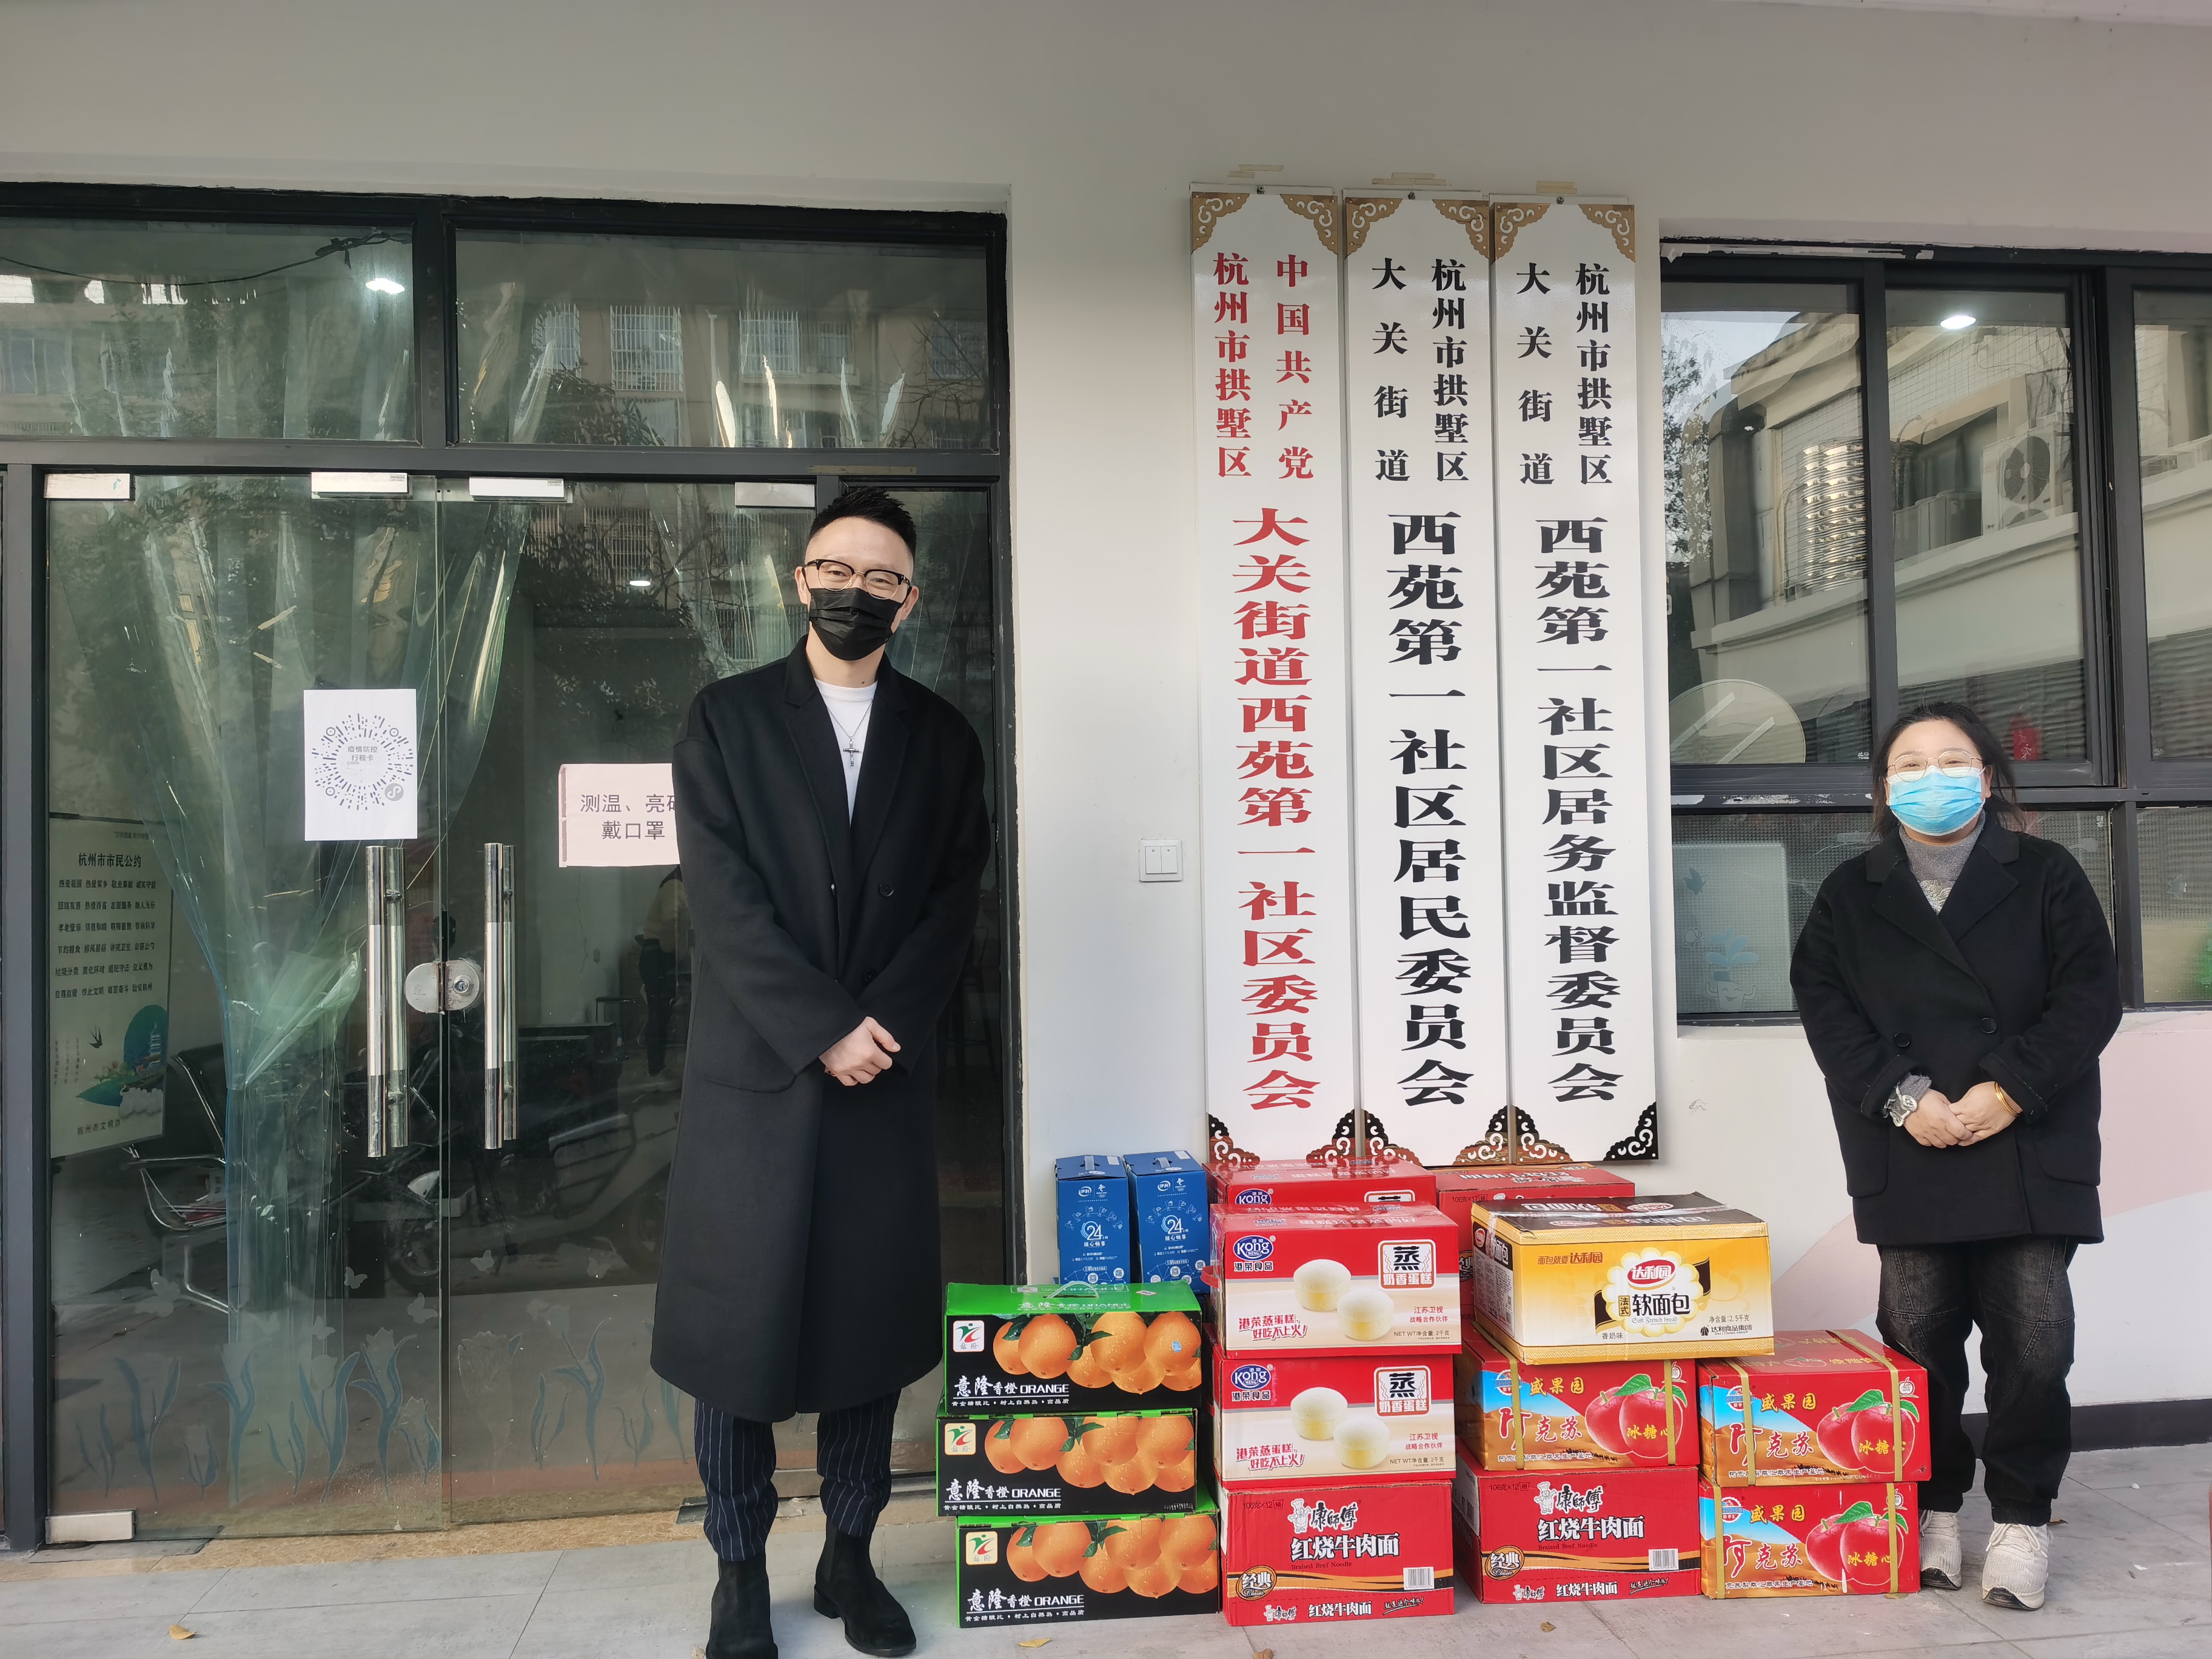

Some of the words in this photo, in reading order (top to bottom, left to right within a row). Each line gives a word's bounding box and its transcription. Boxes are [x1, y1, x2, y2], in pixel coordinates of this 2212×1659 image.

[1213, 252, 1252, 478] 杭州市拱墅区
[1276, 254, 1313, 480] 中国共产党
[1372, 257, 1410, 482] 大关街道
[1431, 259, 1469, 482] 杭州市拱墅区
[1516, 263, 1555, 485] 大关街道
[1575, 263, 1612, 484] 杭州市拱墅区
[1232, 508, 1321, 1110] 大关街道西苑第一社区委员会
[1386, 511, 1474, 1106] 西苑第一社区居民委员会
[1534, 517, 1624, 1102] 西苑第一社区居务监督委员会
[602, 820, 665, 840] 戴口罩
[78, 853, 141, 868] 杭州市市民公约
[1087, 1224, 1102, 1241] 24
[1167, 1218, 1182, 1235] 24
[1238, 1242, 1270, 1257] Kong
[1393, 1245, 1423, 1271] 蒸
[1235, 1262, 1273, 1271] 港荣食品
[1631, 1265, 1672, 1281] 达利园
[1383, 1272, 1432, 1286] 奶香蛋糕
[1620, 1296, 1630, 1315] 法式
[1632, 1293, 1691, 1316] 软面包
[1711, 1324, 1752, 1333] 达利食品集团
[1235, 1370, 1267, 1386] Kong
[1389, 1373, 1416, 1398] 蒸
[1530, 1377, 1584, 1396] 盛果园
[1020, 1384, 1070, 1394] ORANGE
[1233, 1391, 1271, 1401] 港荣食品
[1379, 1399, 1427, 1413] 奶香蛋糕
[1760, 1393, 1816, 1412] 盛果园
[1011, 1488, 1061, 1498] ORANGE
[1750, 1504, 1805, 1524] 盛果园
[1538, 1515, 1644, 1541] 红烧牛肉面
[1291, 1533, 1399, 1561] 红烧牛肉面
[1490, 1552, 1520, 1569] 经典
[1848, 1551, 1892, 1567] 冰糖心
[1241, 1572, 1272, 1589] 经典
[1556, 1581, 1618, 1597] 红烧牛肉面
[1034, 1594, 1084, 1606] ORANGE
[1309, 1601, 1372, 1617] 红烧牛肉面
